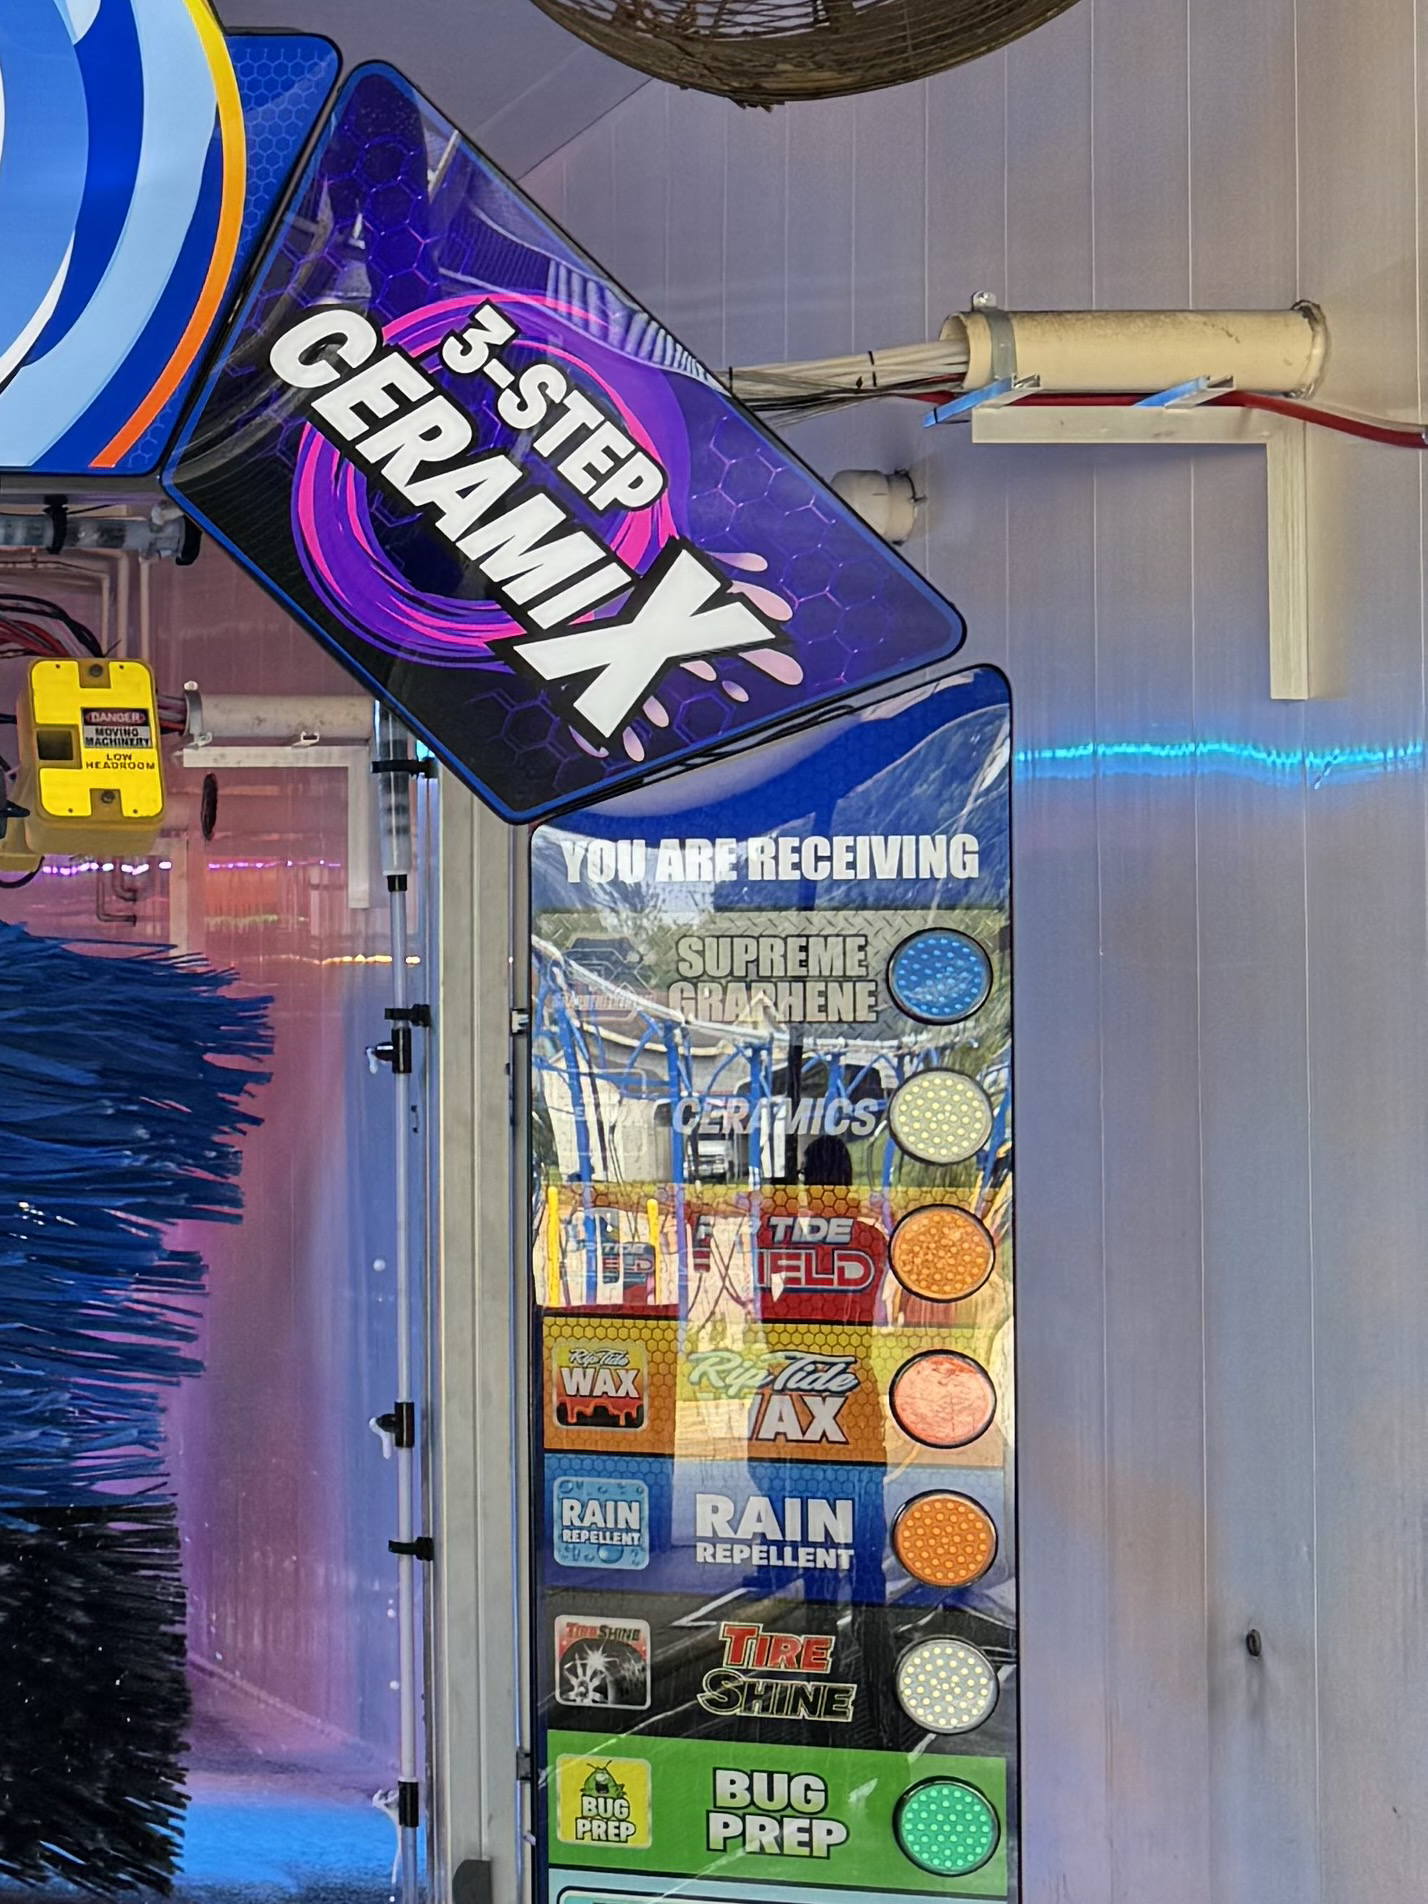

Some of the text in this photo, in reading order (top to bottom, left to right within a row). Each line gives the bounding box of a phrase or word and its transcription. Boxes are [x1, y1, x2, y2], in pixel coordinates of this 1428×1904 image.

[442, 303, 665, 512] 3-STEP
[269, 308, 778, 738] CERAMIX
[91, 711, 142, 723] DANGER
[95, 727, 139, 737] MOVING
[85, 737, 149, 747] MACHINERY
[106, 753, 132, 761] LOW
[86, 761, 155, 770] HEADROOM
[562, 834, 979, 884] YOU ARE RECEIVING
[676, 934, 868, 978] SUPREME
[668, 981, 877, 1023] GRAPHENE
[671, 1097, 876, 1136] CERAMICS
[769, 1216, 856, 1243] TIDE
[561, 1367, 640, 1398] WAX
[687, 1349, 861, 1395] Rip Tide
[562, 1498, 640, 1530] RAIN
[696, 1494, 853, 1543] RAIN
[562, 1530, 640, 1546] REPELLENT
[696, 1543, 855, 1570] REPELLENT
[720, 1621, 835, 1674] TIRE
[696, 1668, 858, 1722] SHINE
[581, 1794, 630, 1819] BUG
[713, 1768, 828, 1813] BUG
[575, 1818, 636, 1844] PREP
[707, 1812, 849, 1858] PREP
